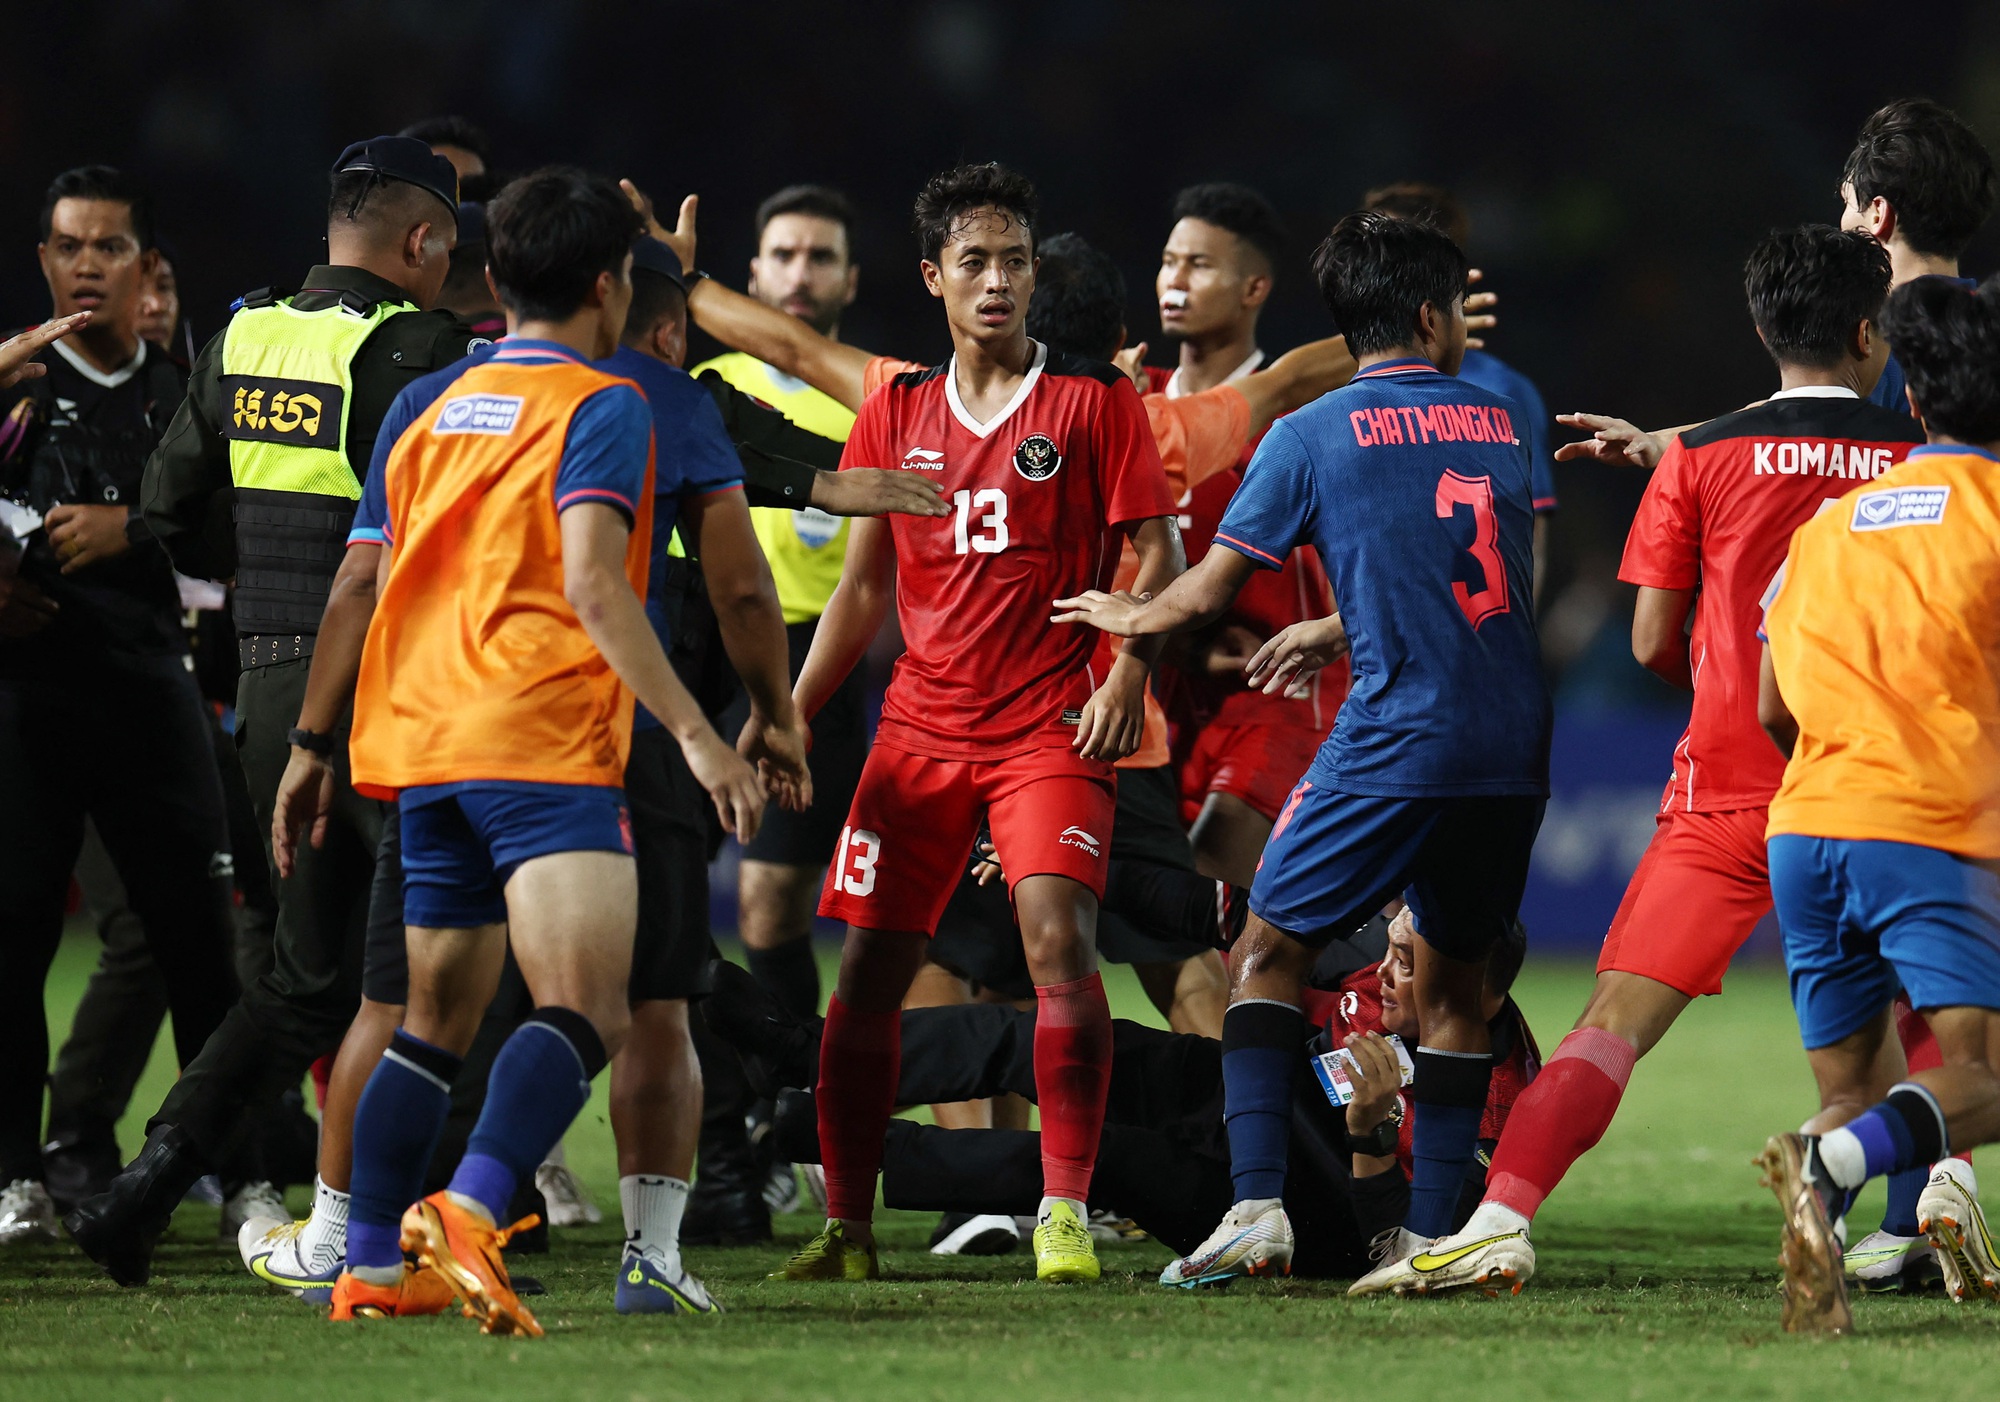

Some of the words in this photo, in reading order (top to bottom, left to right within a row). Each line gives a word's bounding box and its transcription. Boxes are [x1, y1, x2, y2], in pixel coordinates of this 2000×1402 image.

[1350, 404, 1520, 447] CHATMONGKOL
[901, 461, 944, 471] LI-NING
[1753, 442, 1893, 481] KOMANG
[953, 488, 1010, 555] 13
[1898, 505, 1940, 519] SPORT
[1435, 468, 1510, 632] 3
[834, 825, 881, 898] 13
[1058, 836, 1100, 858] LI-NING
